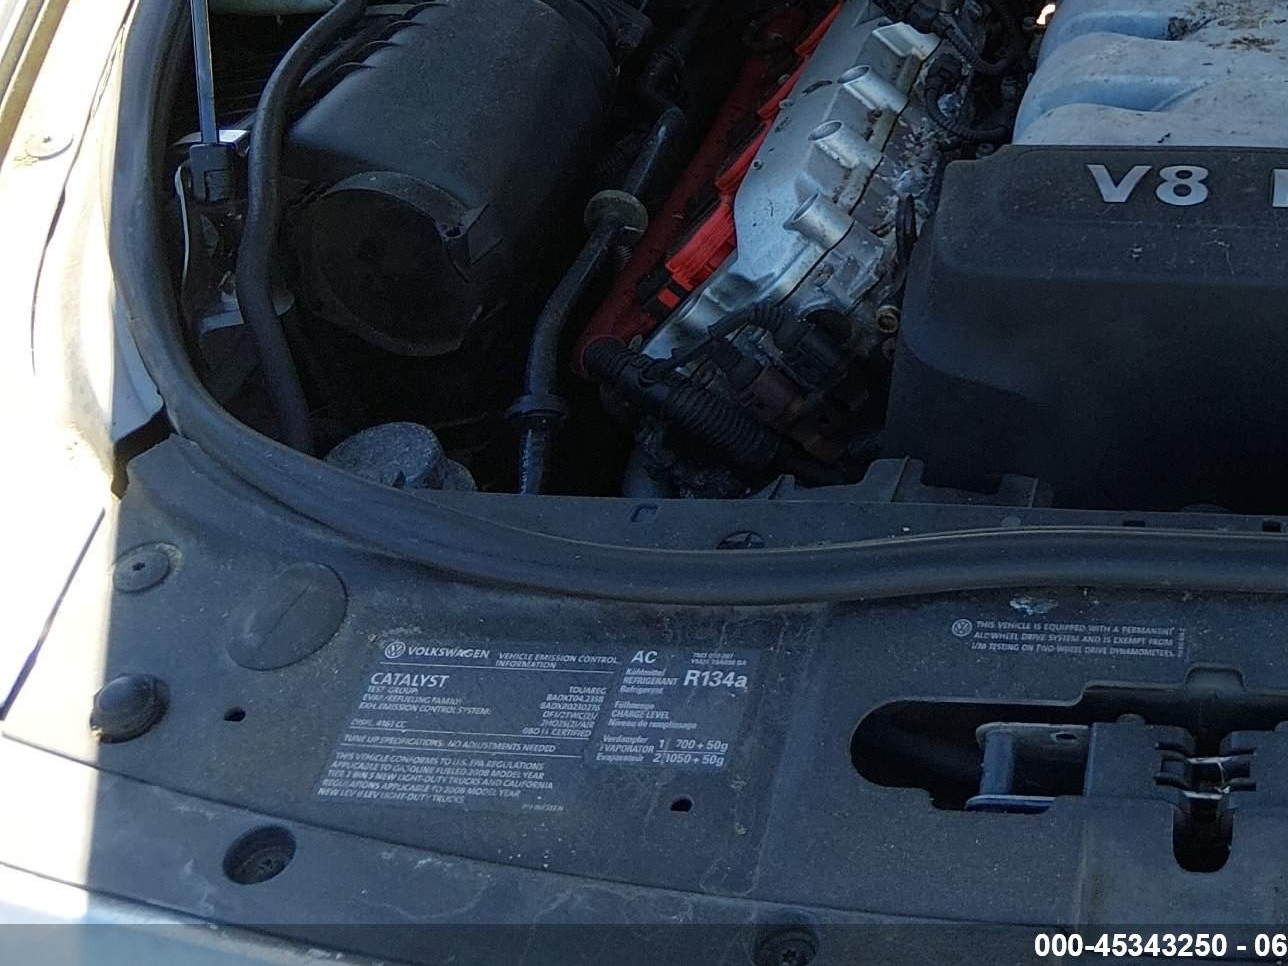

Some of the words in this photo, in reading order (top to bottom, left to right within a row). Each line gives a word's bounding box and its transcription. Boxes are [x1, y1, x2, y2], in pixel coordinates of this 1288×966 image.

[1087, 164, 1209, 206] V8
[976, 621, 995, 629] THIS
[998, 621, 1031, 630] VEHICLE
[1033, 622, 1042, 631] IS
[1044, 622, 1086, 633] EQUIPPED
[1088, 624, 1110, 633] WITH
[1112, 625, 1120, 633] A
[1021, 633, 1046, 642] DRIVE
[1082, 635, 1101, 643] AND
[1103, 636, 1111, 644] IS
[408, 646, 490, 659] VOLKSWAGEN
[500, 652, 532, 661] VEHICLE
[535, 653, 577, 663] EMISSION
[578, 655, 618, 664] CONTROL
[631, 650, 658, 664] AC
[495, 660, 556, 669] INFORMATION
[370, 672, 450, 688] CATALYST
[623, 676, 680, 686] REFRIGERANT
[683, 669, 748, 688] R134a
[611, 709, 645, 719] CHARGE
[646, 711, 671, 720] LEVEL
[551, 728, 592, 738] CERTIFIED
[447, 740, 461, 748] NO
[462, 740, 521, 751] ADJUSTMENTS
[522, 744, 557, 753] NEEDED
[599, 744, 655, 754] EVAPORATOR
[675, 739, 696, 750] 700
[706, 740, 729, 753] 50g
[440, 757, 452, 765] TO
[486, 760, 545, 771] REGULATIONS
[652, 753, 662, 763] 2
[665, 753, 692, 764] 1050
[702, 754, 725, 767] 50g
[380, 762, 392, 771] TO
[490, 769, 521, 779] MODEL
[523, 771, 545, 780] YEAR
[449, 776, 481, 786] TRUCKS
[481, 778, 502, 787] AND
[502, 779, 553, 790] CALIFORNIA
